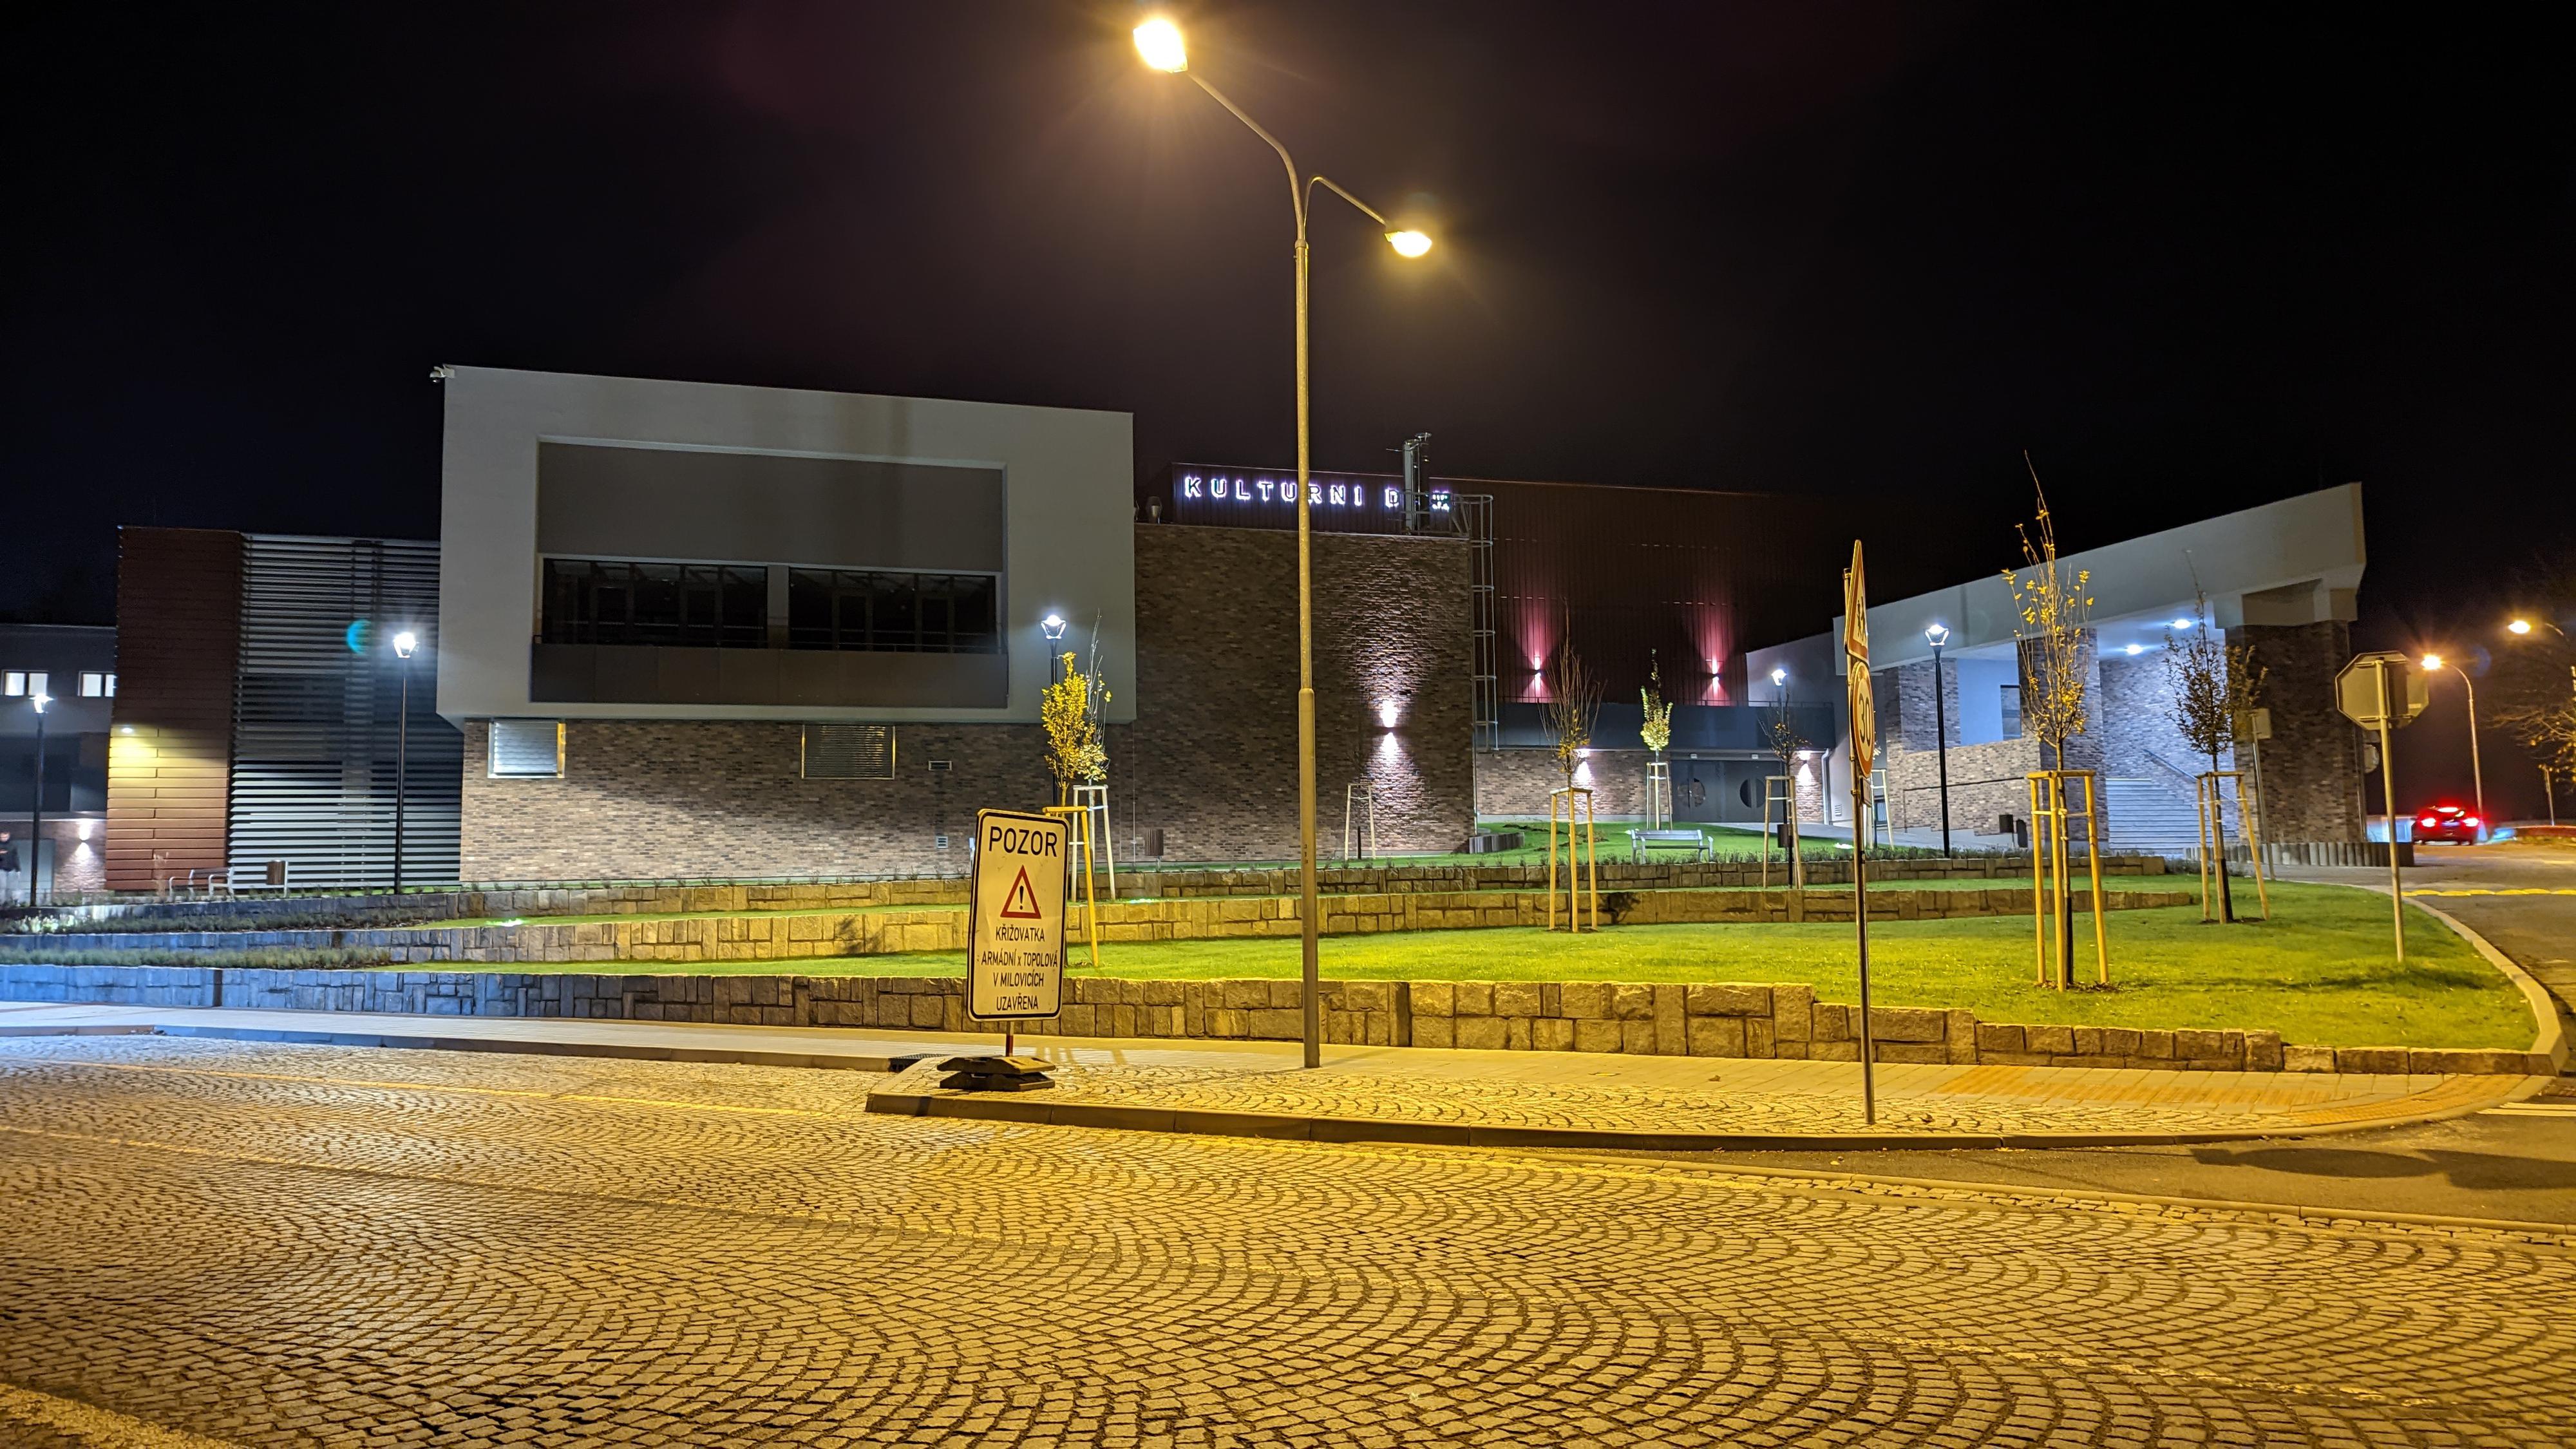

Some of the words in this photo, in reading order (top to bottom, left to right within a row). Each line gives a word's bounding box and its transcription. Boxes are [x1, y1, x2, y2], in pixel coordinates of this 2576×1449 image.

[1859, 693, 1871, 746] 30
[989, 826, 1057, 857] POZOR
[996, 923, 1045, 942] KŘIŽOVATKA
[981, 948, 1017, 966] ARMÁDNÍ
[1023, 950, 1058, 967] TOPOLOVÁ
[993, 972, 999, 987] V
[1000, 969, 1044, 987] MILOVICÍCH
[996, 992, 1039, 1011] UZAVŘENA
